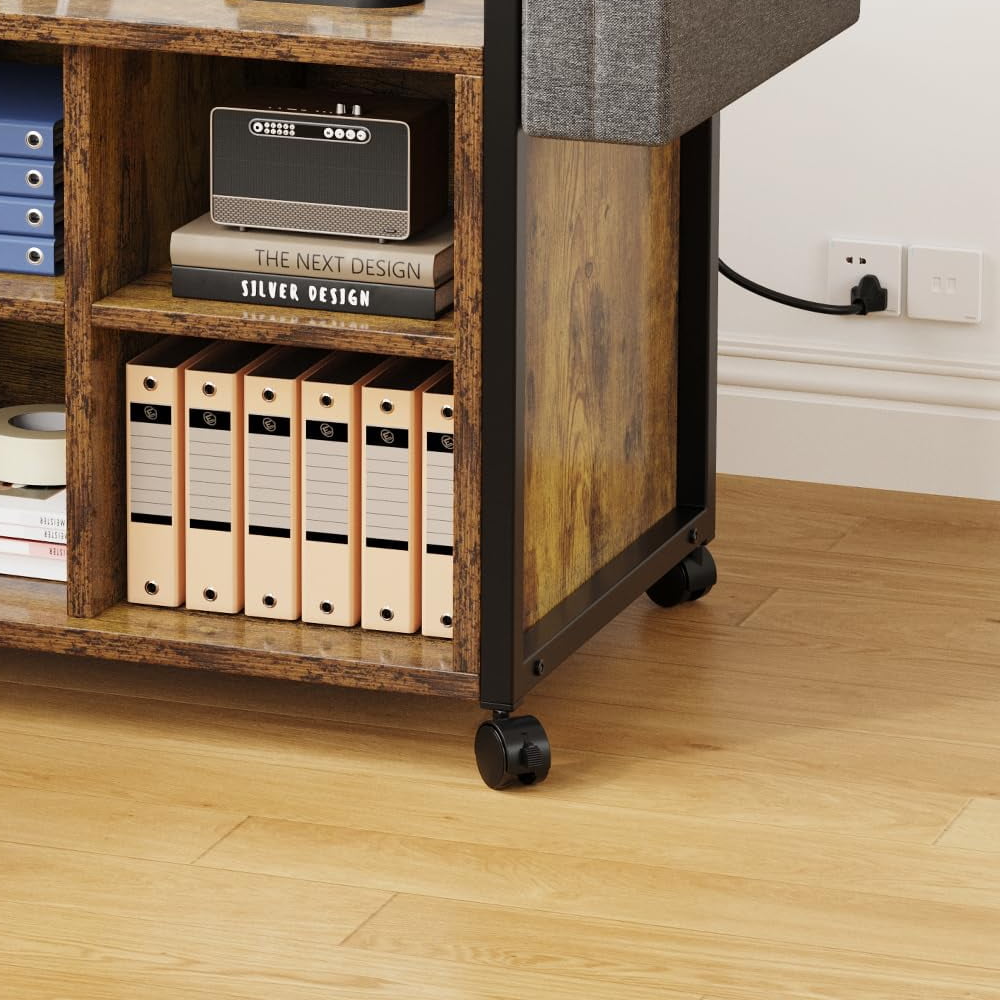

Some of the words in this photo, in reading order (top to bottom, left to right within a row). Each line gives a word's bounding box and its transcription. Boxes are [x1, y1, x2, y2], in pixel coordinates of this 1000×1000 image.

[255, 248, 290, 268] THE
[296, 252, 345, 273] NEXT
[352, 257, 422, 280] DESIGN
[241, 279, 300, 302] SILVER
[308, 284, 371, 308] DESIGN
